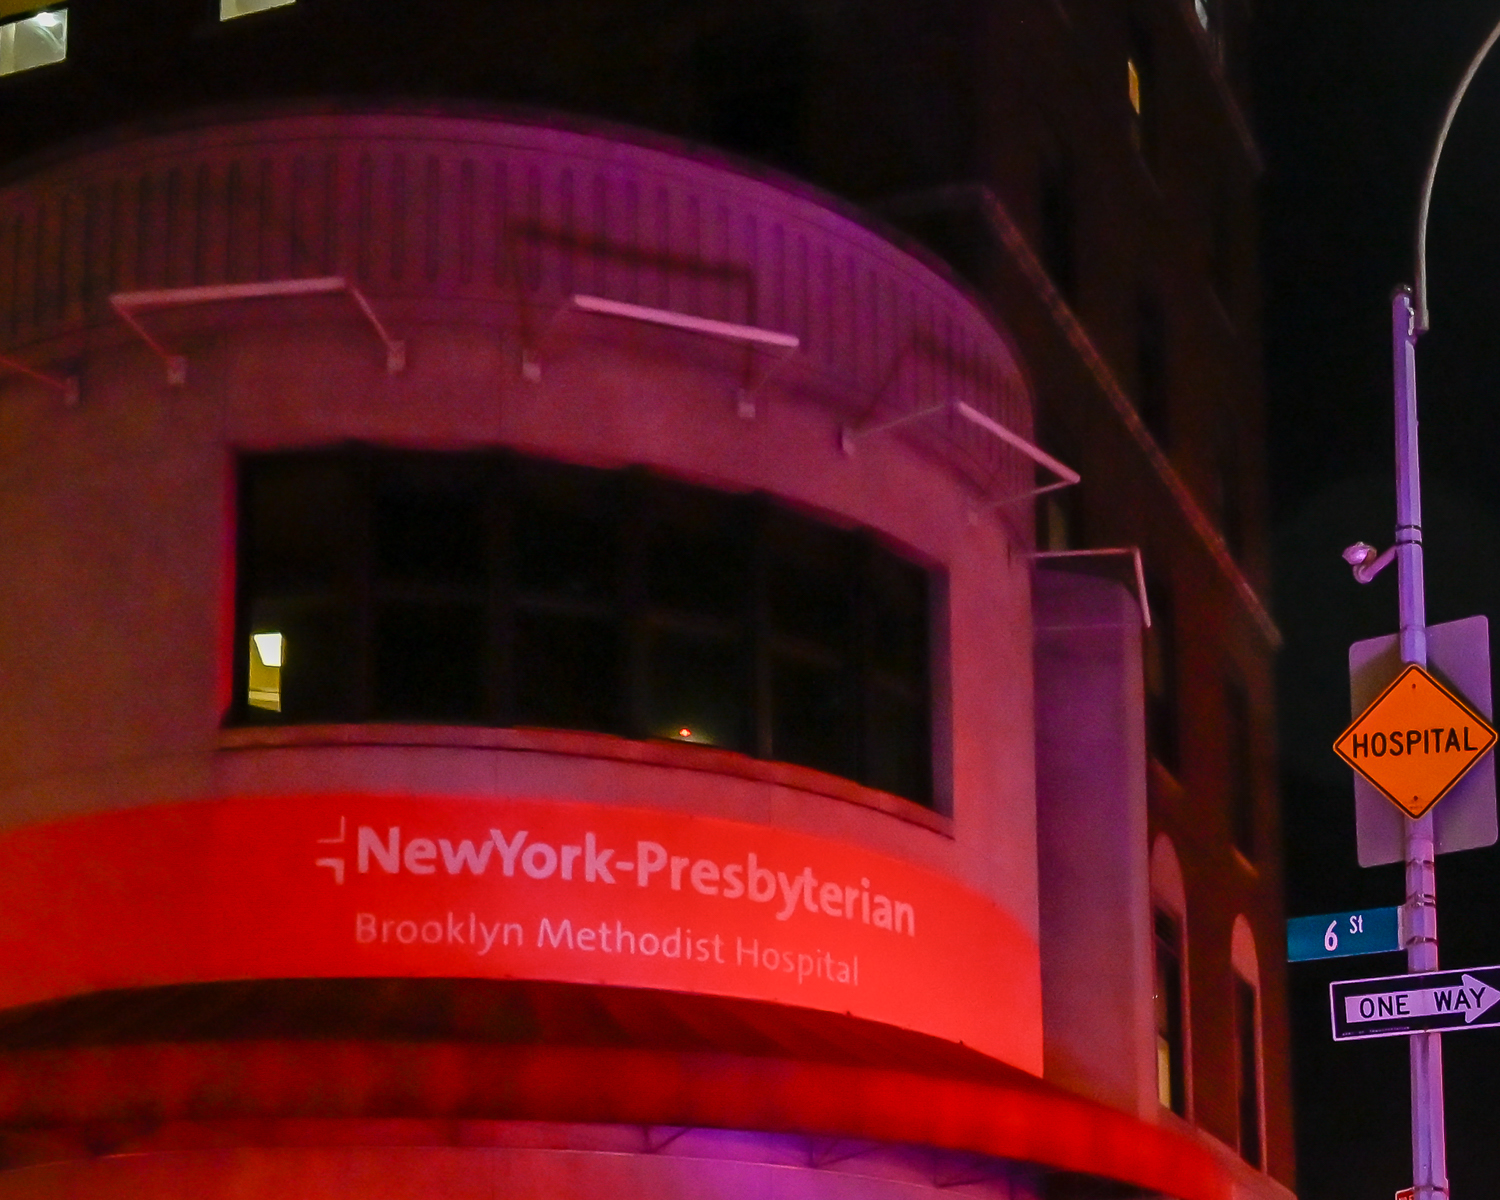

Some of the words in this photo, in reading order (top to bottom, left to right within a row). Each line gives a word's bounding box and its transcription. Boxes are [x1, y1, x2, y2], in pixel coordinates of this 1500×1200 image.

[1352, 726, 1479, 759] HOSPITAL
[357, 825, 915, 937] NewYork-Presbyterian
[356, 911, 523, 956] Brooklyn
[537, 917, 725, 964] Methodist
[736, 936, 859, 986] Hospital
[1323, 919, 1338, 952] 6
[1349, 914, 1364, 934] St
[1359, 993, 1411, 1020] ONE
[1433, 986, 1487, 1012] WAY
